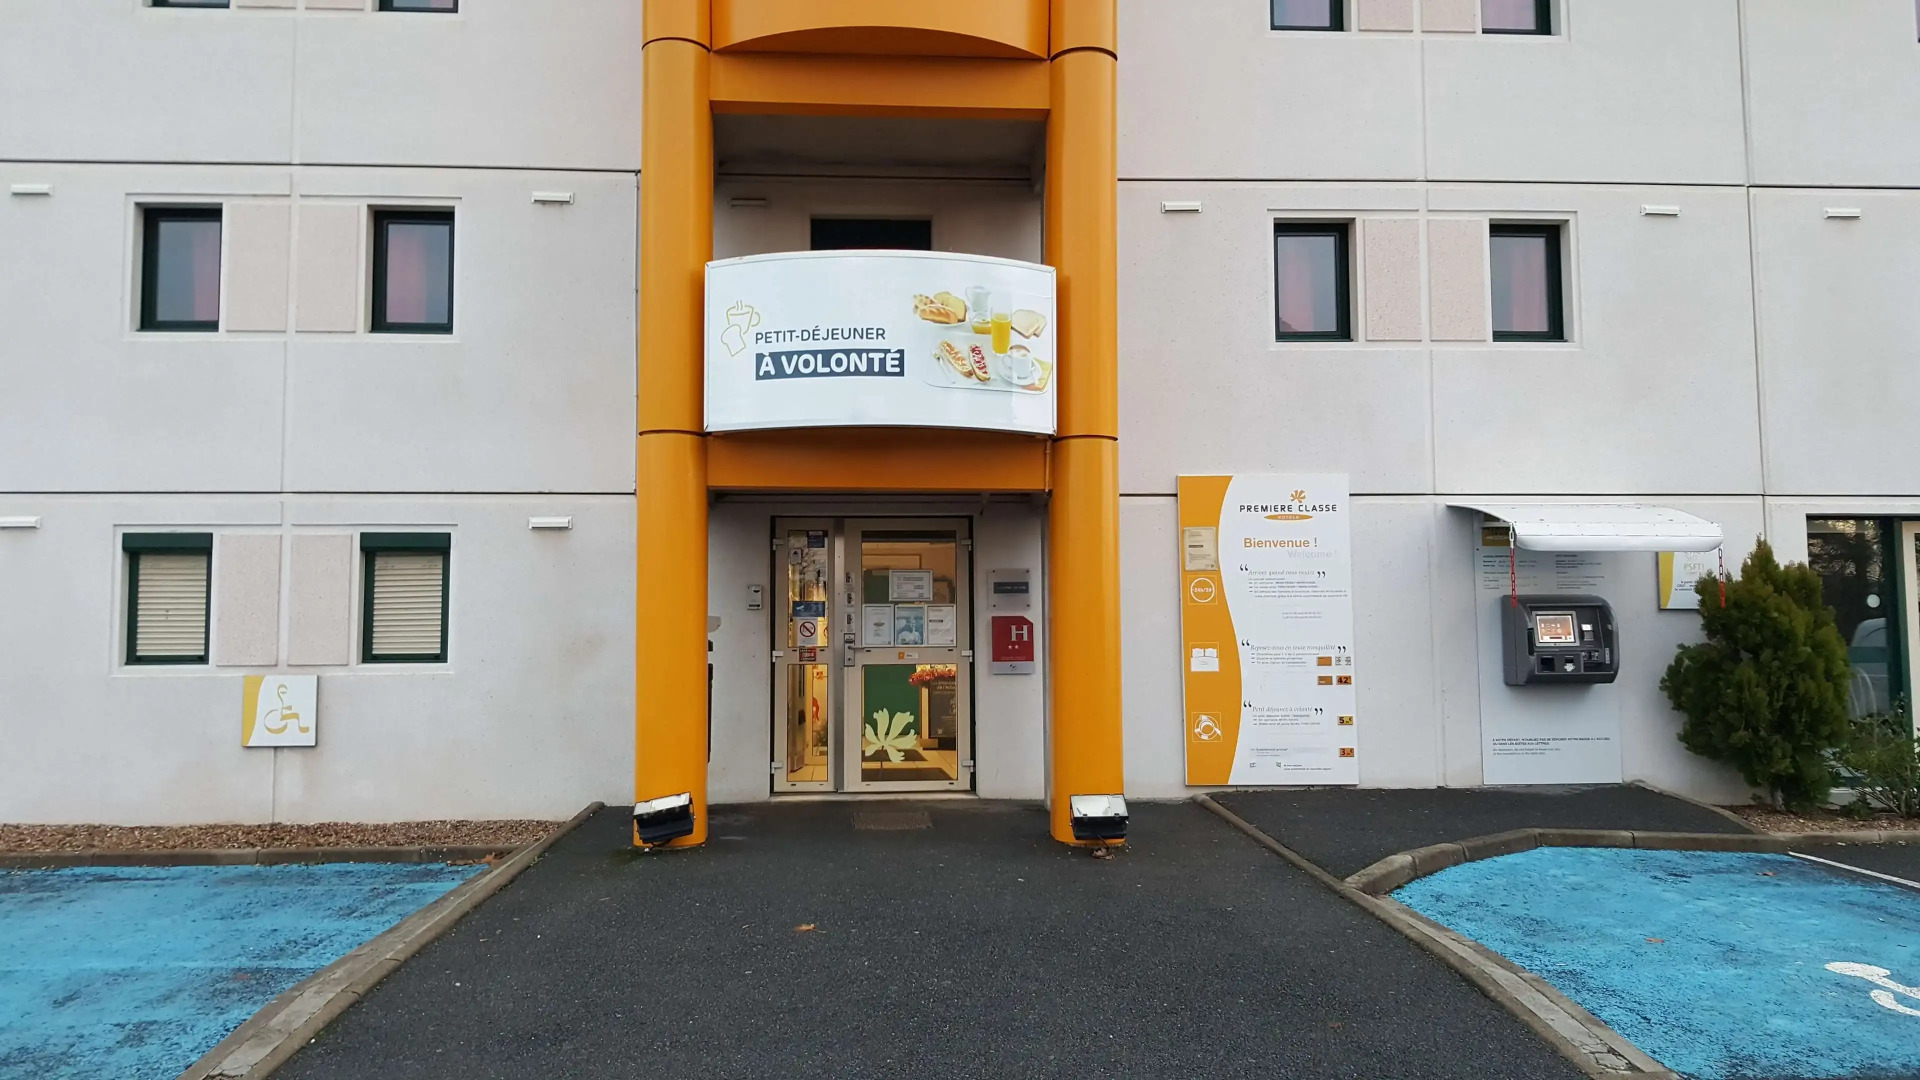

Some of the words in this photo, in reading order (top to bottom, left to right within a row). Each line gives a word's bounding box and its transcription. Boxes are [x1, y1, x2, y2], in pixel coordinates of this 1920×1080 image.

[755, 325, 886, 344] PETIT-DÉJEUNER
[758, 352, 776, 376] À
[781, 348, 901, 375] VOLONTÉ
[1239, 504, 1293, 513] PREMIERE
[1298, 504, 1338, 512] CLASSE
[1243, 537, 1310, 548] Bienvenue
[1287, 549, 1332, 559] Welcome
[1010, 624, 1029, 641] H
